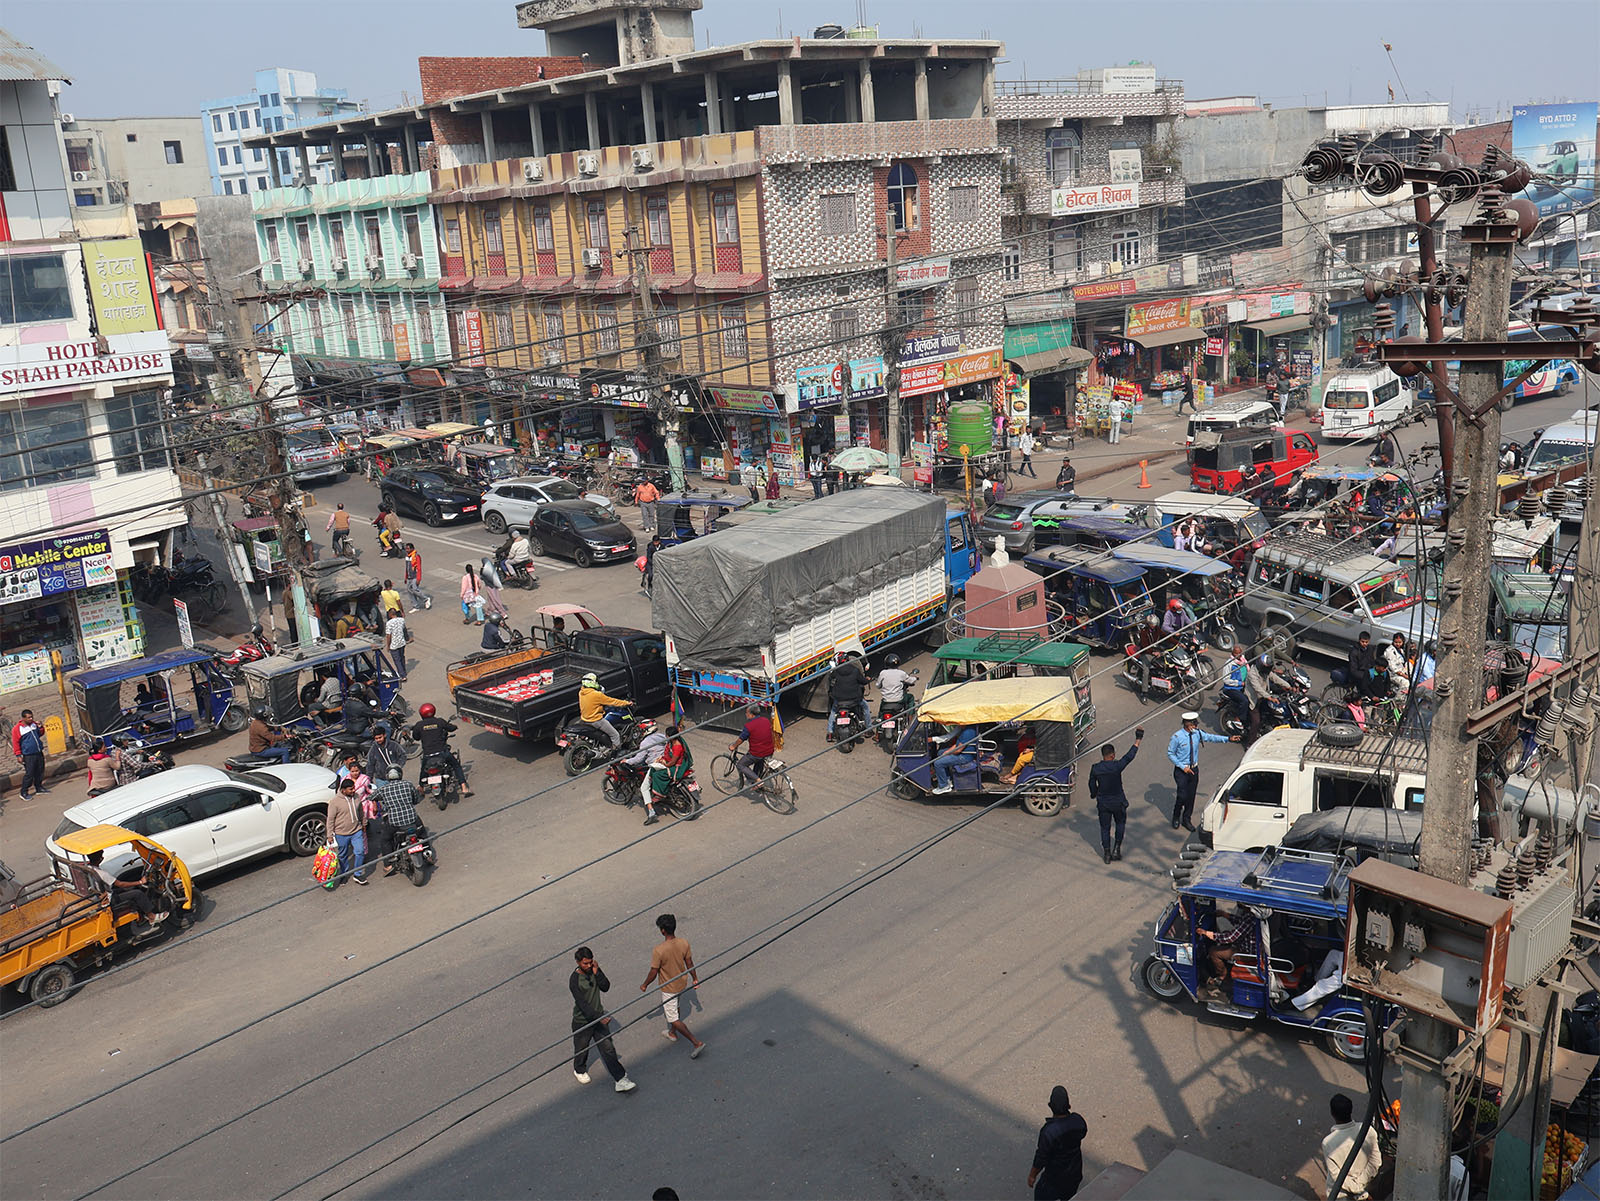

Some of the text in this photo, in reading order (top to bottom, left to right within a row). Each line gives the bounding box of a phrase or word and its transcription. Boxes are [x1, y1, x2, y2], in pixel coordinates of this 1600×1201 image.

[1539, 113, 1577, 124] BYD ATTO 2
[1066, 187, 1132, 208] होटल शिवम्
[96, 254, 136, 281] होटल
[896, 270, 909, 282] टल
[102, 280, 140, 300] शाह
[1074, 284, 1119, 297] HOTEL SHIVAM
[941, 332, 961, 348] नेपाल
[46, 341, 115, 361] HOT
[2, 353, 163, 386] SHAH PARADISE
[531, 375, 580, 390] GALAXY MOBILE
[0, 542, 107, 571] a Mobile Center
[86, 558, 107, 568] Ncell
[42, 577, 65, 592] 4G
